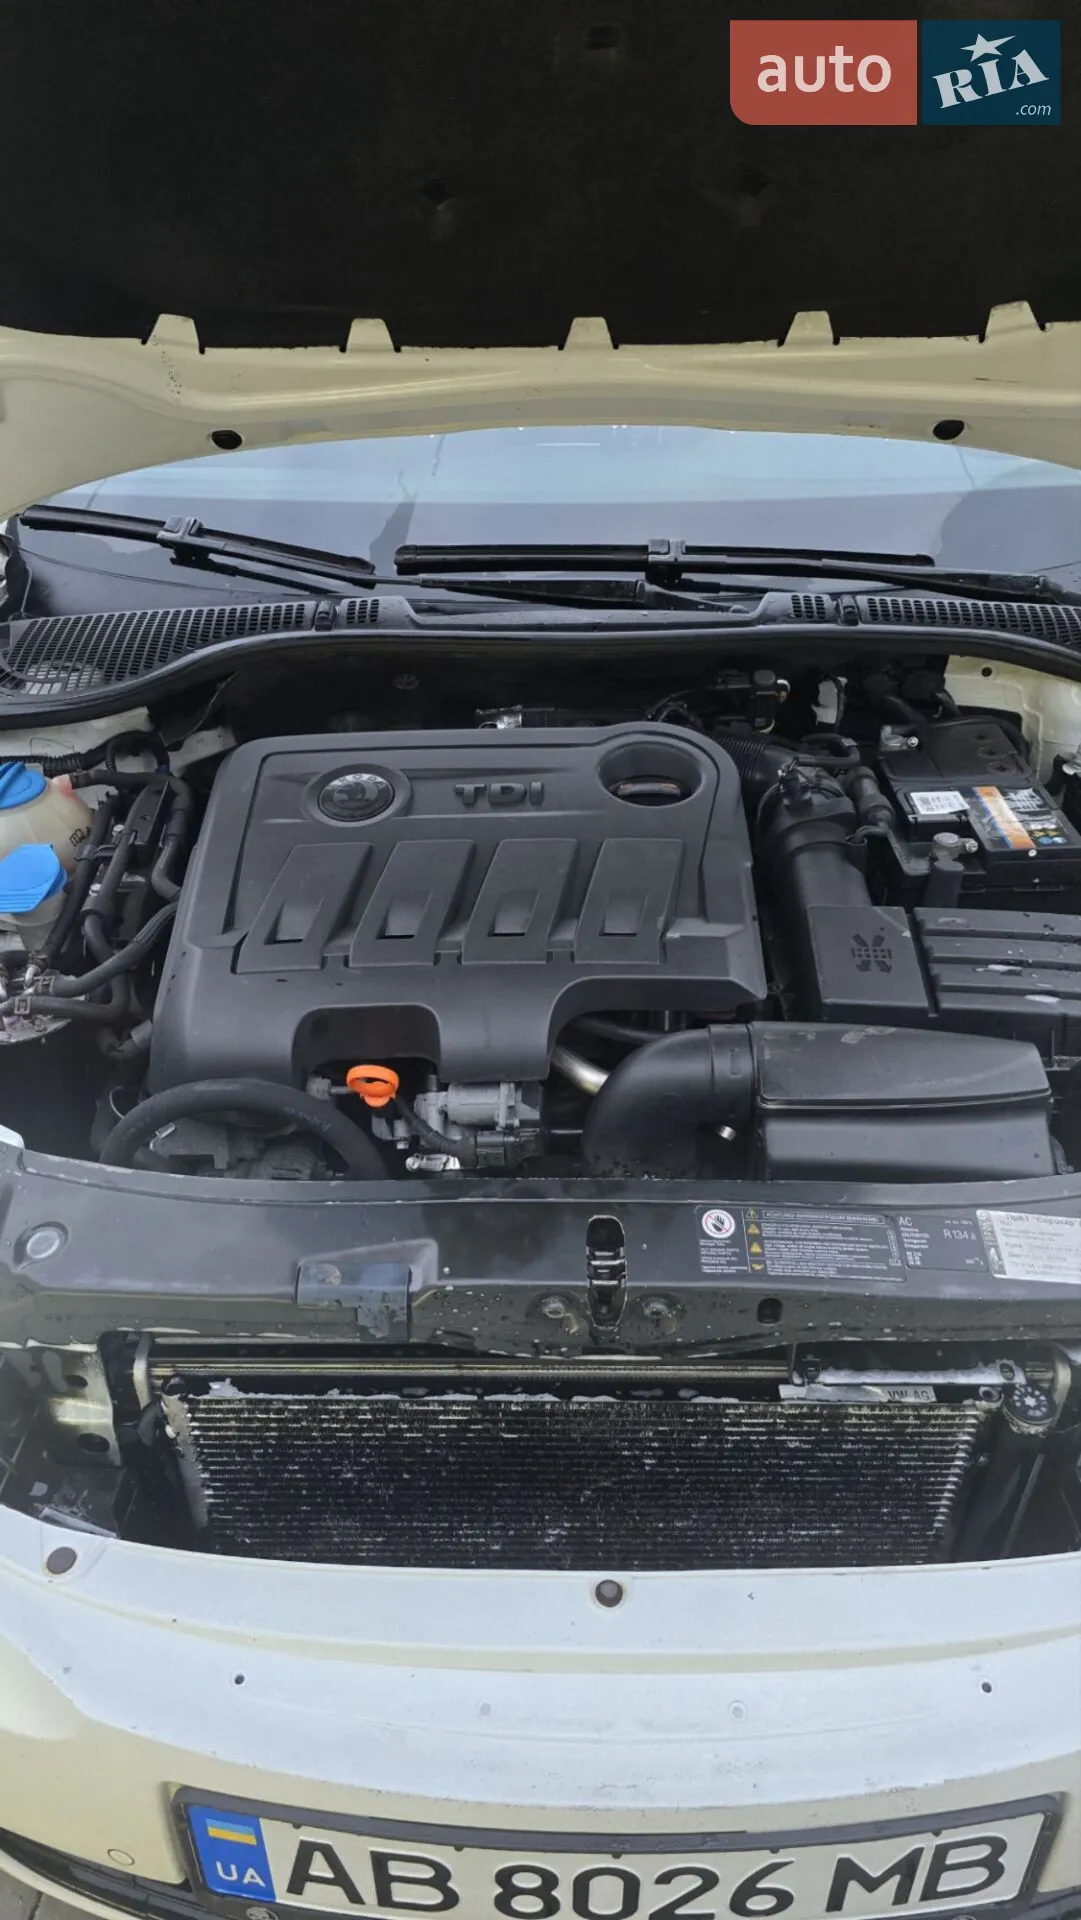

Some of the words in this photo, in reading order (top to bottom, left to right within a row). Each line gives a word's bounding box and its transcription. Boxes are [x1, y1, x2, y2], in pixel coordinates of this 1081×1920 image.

[454, 781, 545, 808] TDI
[899, 1216, 913, 1226] AC
[943, 1229, 952, 1239] R
[952, 1229, 969, 1241] 134
[216, 1861, 266, 1888] UA
[286, 1838, 460, 1913] AB
[494, 1859, 795, 1920] 8026
[825, 1834, 1008, 1913] MB
